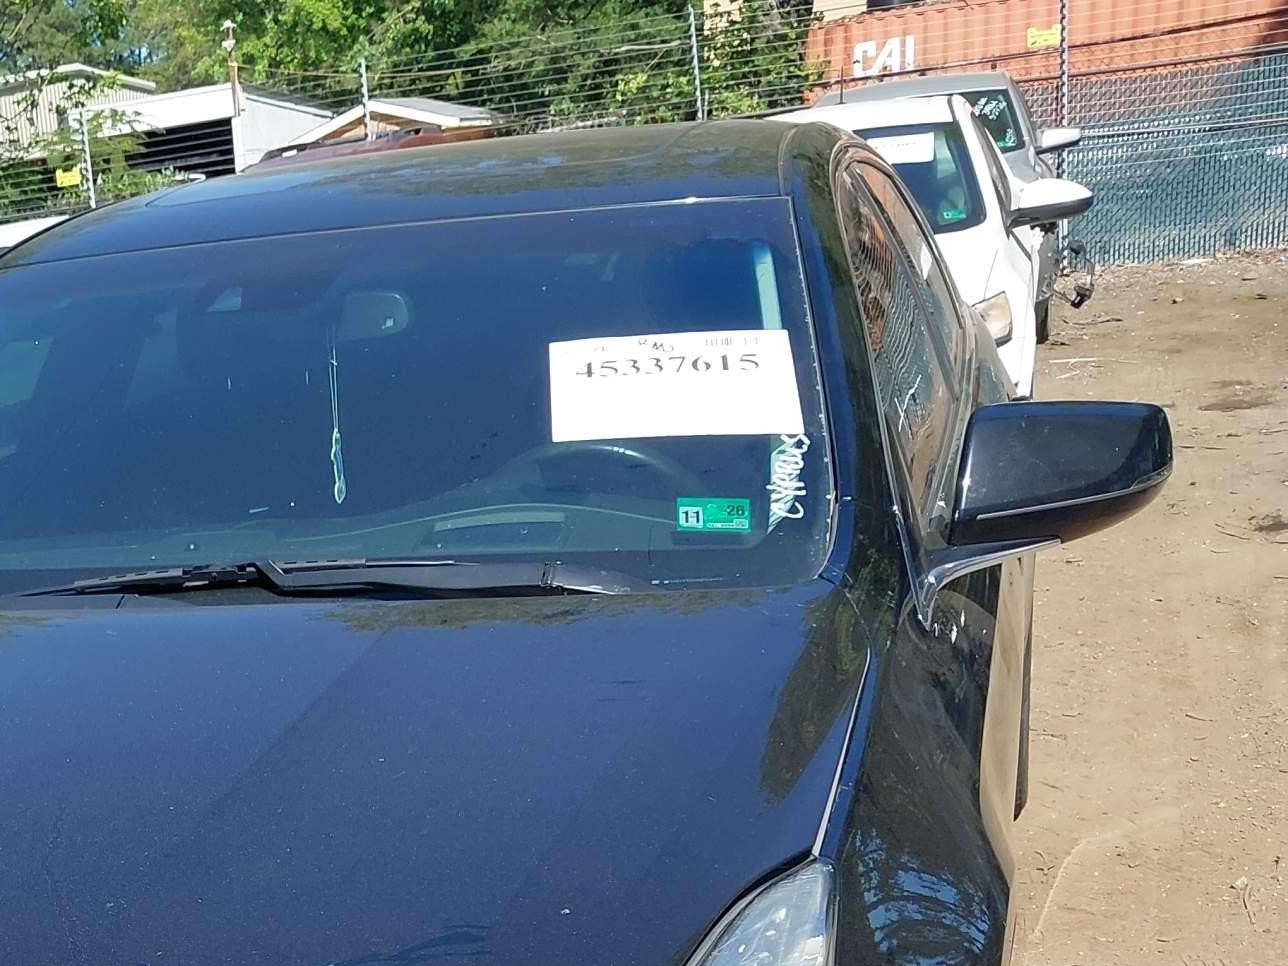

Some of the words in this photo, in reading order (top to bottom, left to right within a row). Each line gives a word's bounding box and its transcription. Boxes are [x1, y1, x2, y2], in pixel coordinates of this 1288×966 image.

[852, 34, 915, 77] CAI
[576, 352, 760, 379] 45337615
[680, 510, 701, 524] 11
